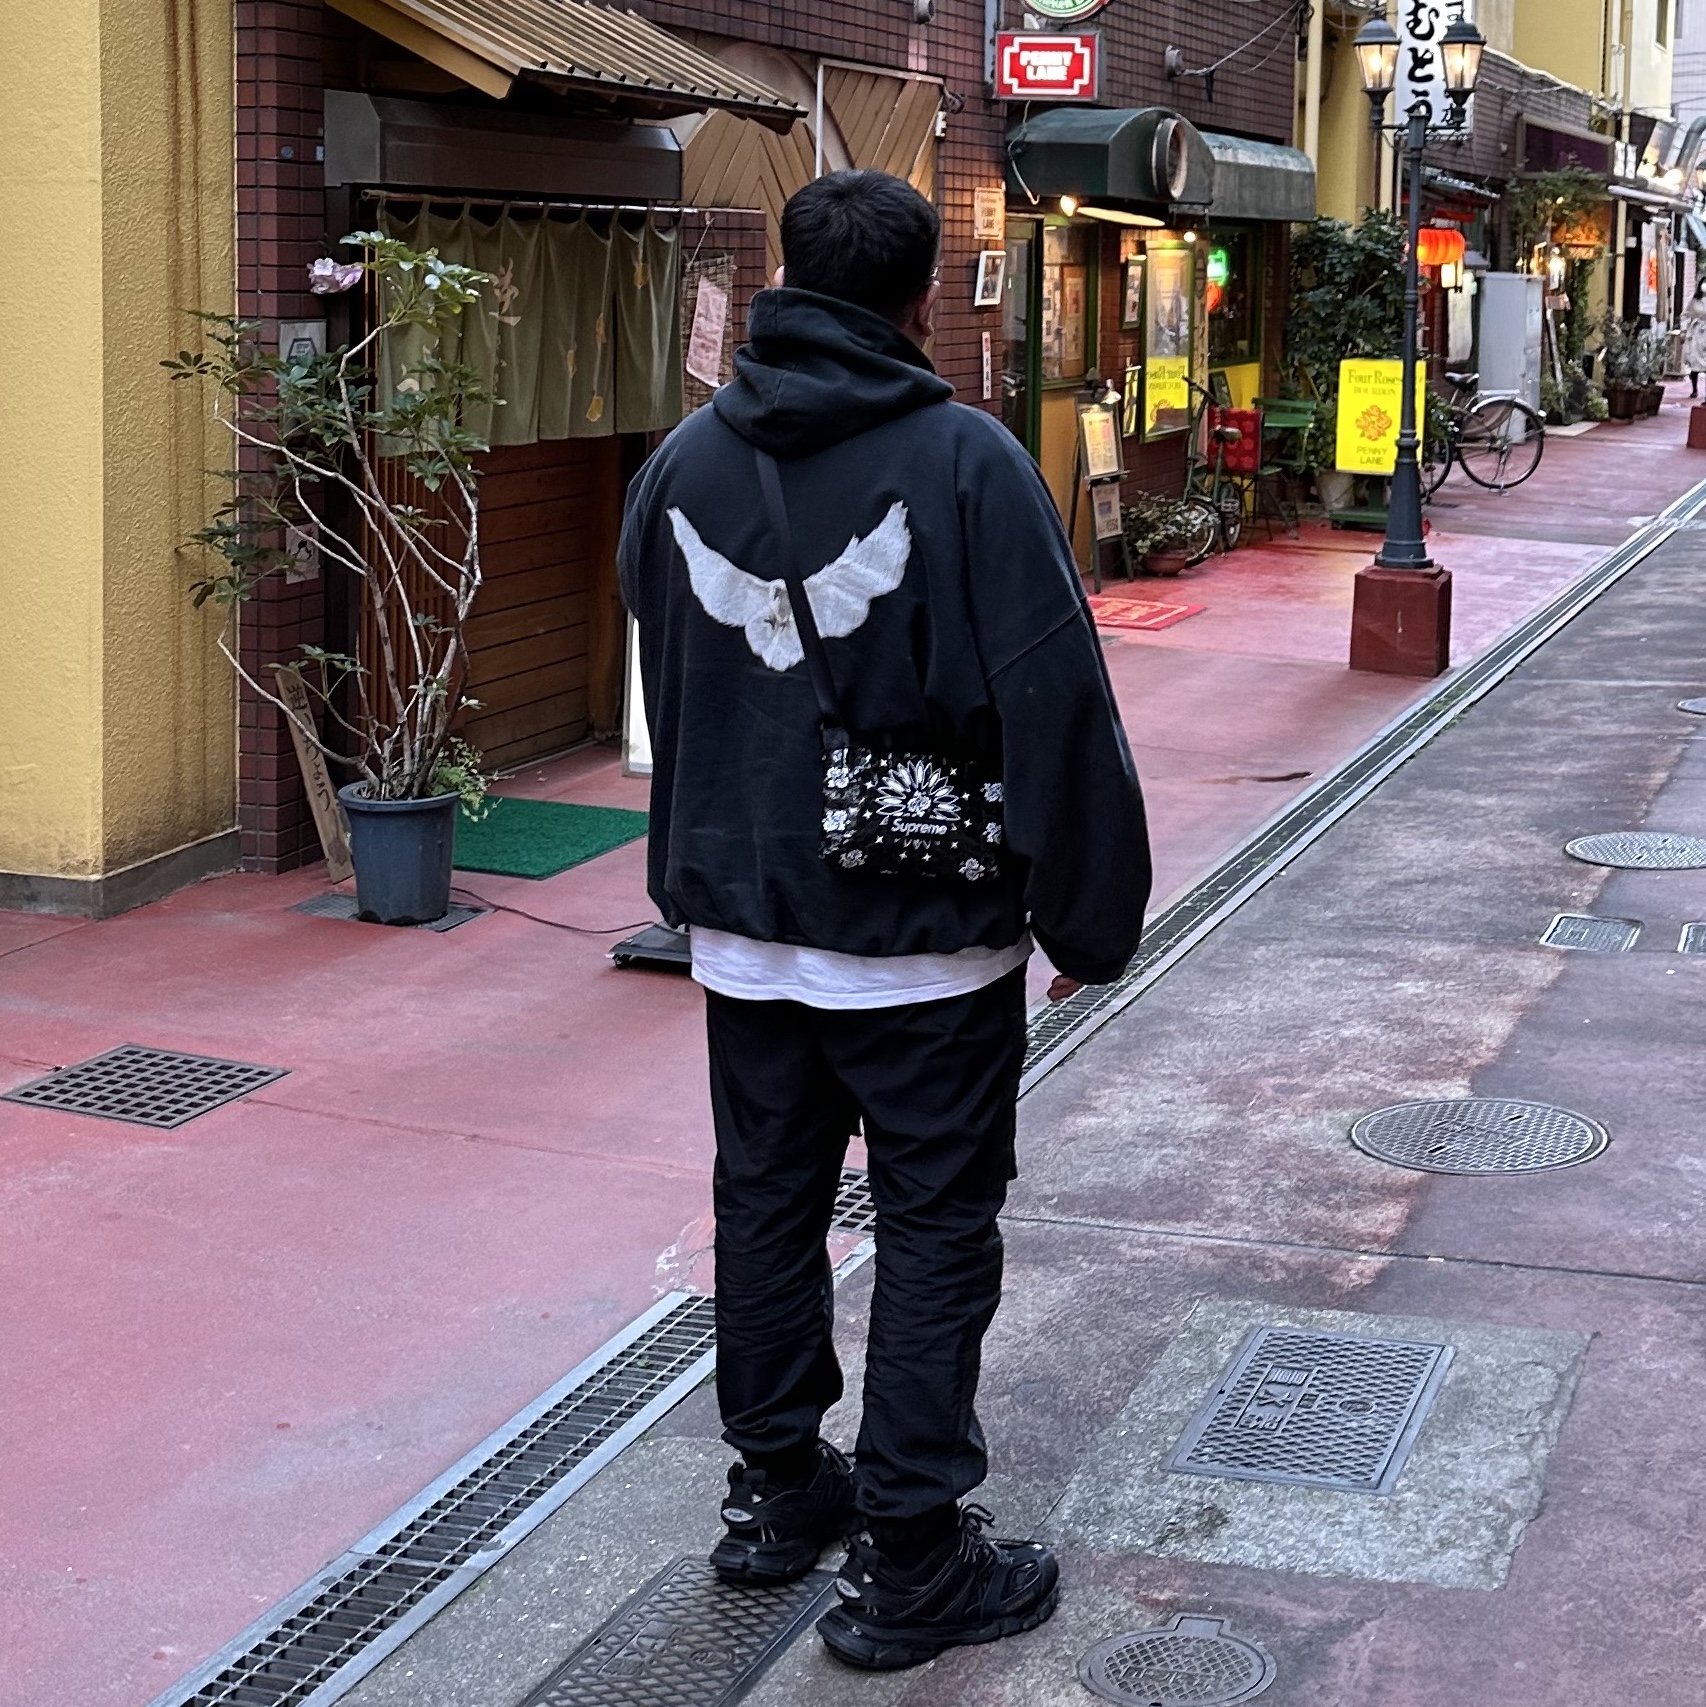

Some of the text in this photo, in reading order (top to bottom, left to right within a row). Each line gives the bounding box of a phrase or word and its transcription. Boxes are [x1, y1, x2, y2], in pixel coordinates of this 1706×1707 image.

[1347, 368, 1373, 384] Four
[1356, 445, 1388, 456] PENNY
[1359, 456, 1385, 466] LANE
[891, 817, 948, 837] Supreme
